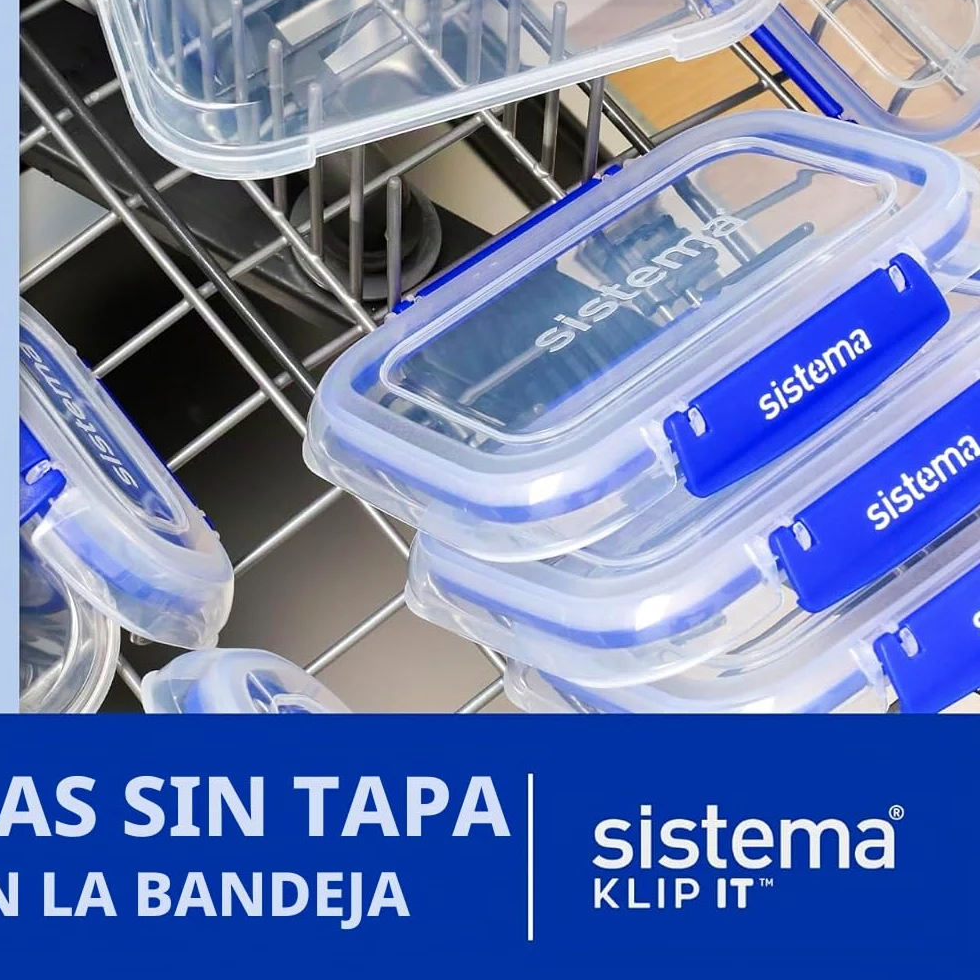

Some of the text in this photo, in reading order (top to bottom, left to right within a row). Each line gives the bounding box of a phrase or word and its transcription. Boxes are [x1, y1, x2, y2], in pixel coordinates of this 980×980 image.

[535, 212, 747, 353] sistema
[759, 328, 872, 420] sistema
[867, 435, 980, 530] sistema
